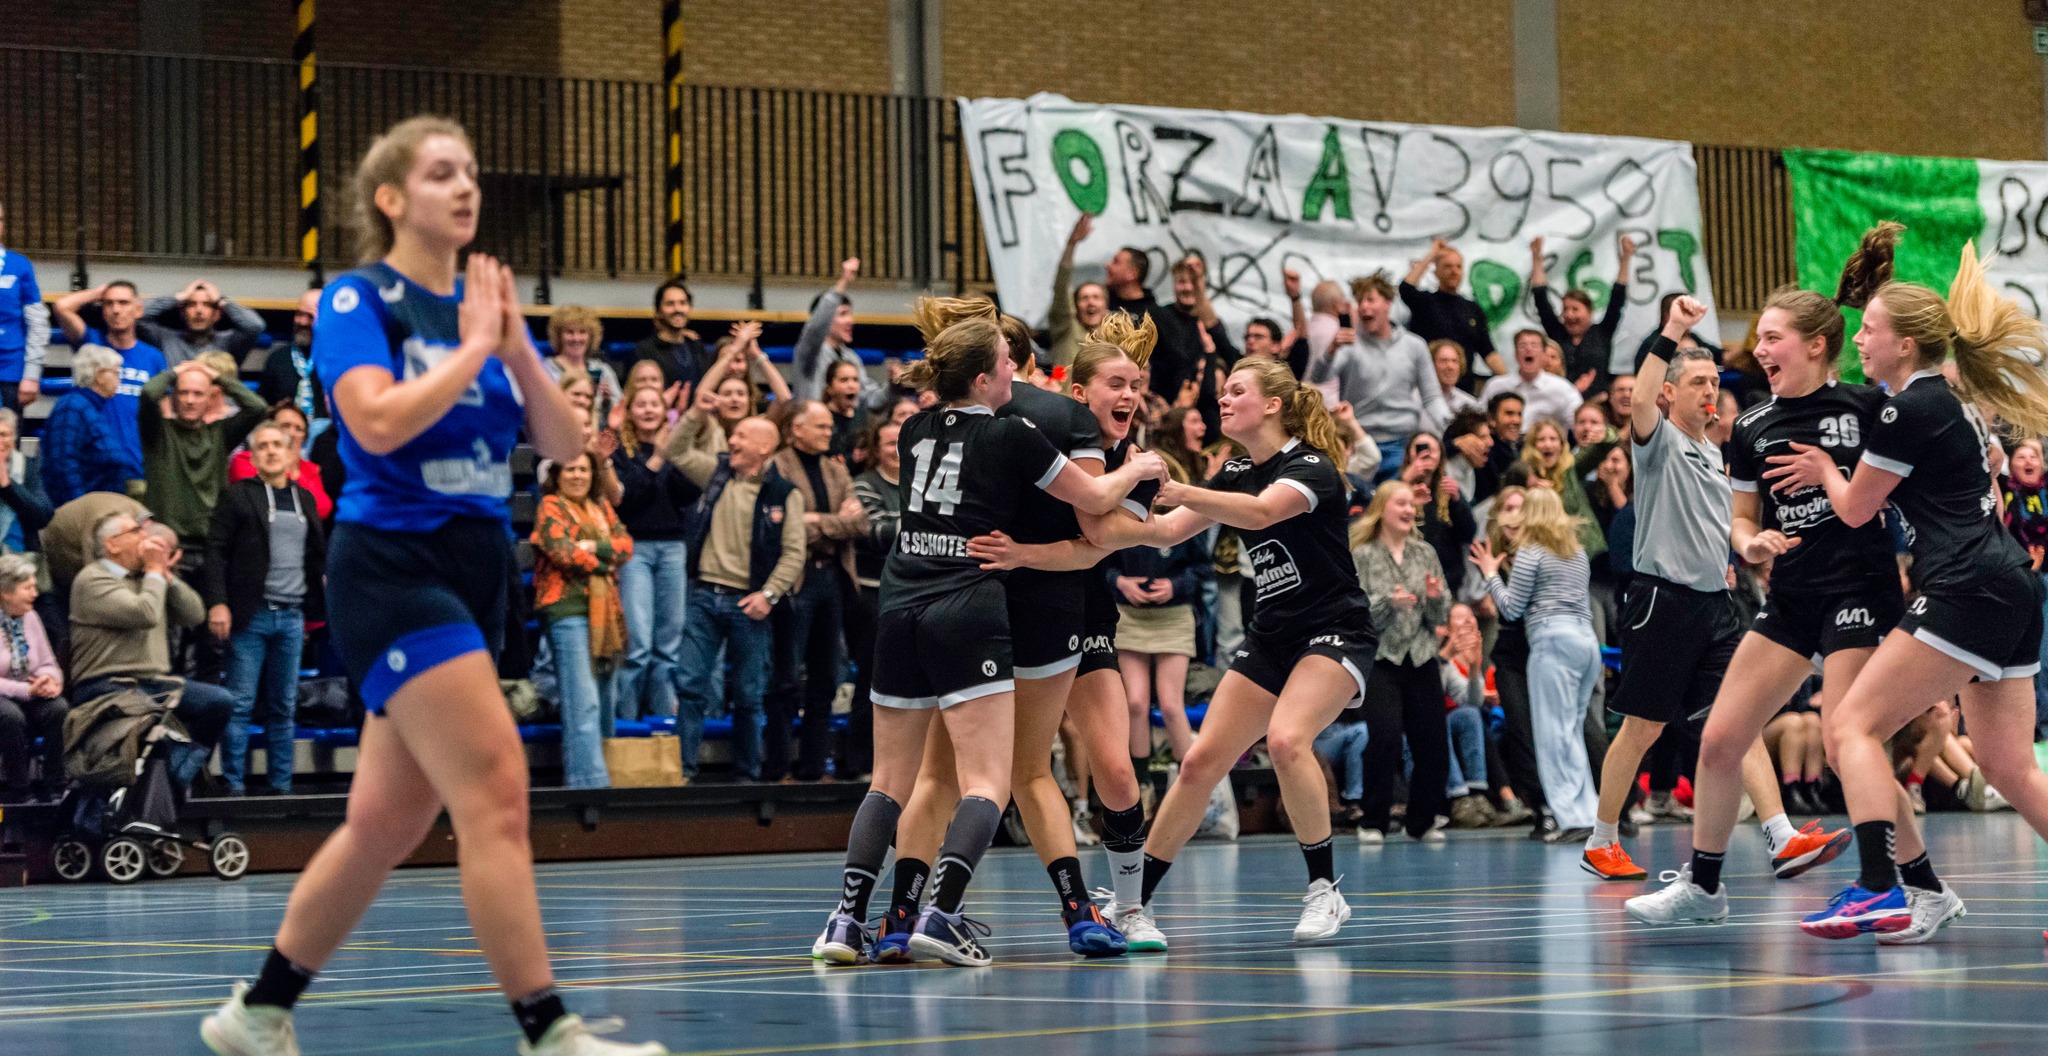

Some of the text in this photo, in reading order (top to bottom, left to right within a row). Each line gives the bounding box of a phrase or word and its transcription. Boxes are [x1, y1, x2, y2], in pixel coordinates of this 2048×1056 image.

[908, 438, 964, 516] 14
[901, 531, 911, 554] C
[983, 662, 996, 675] K
[906, 872, 925, 902] Kempa
